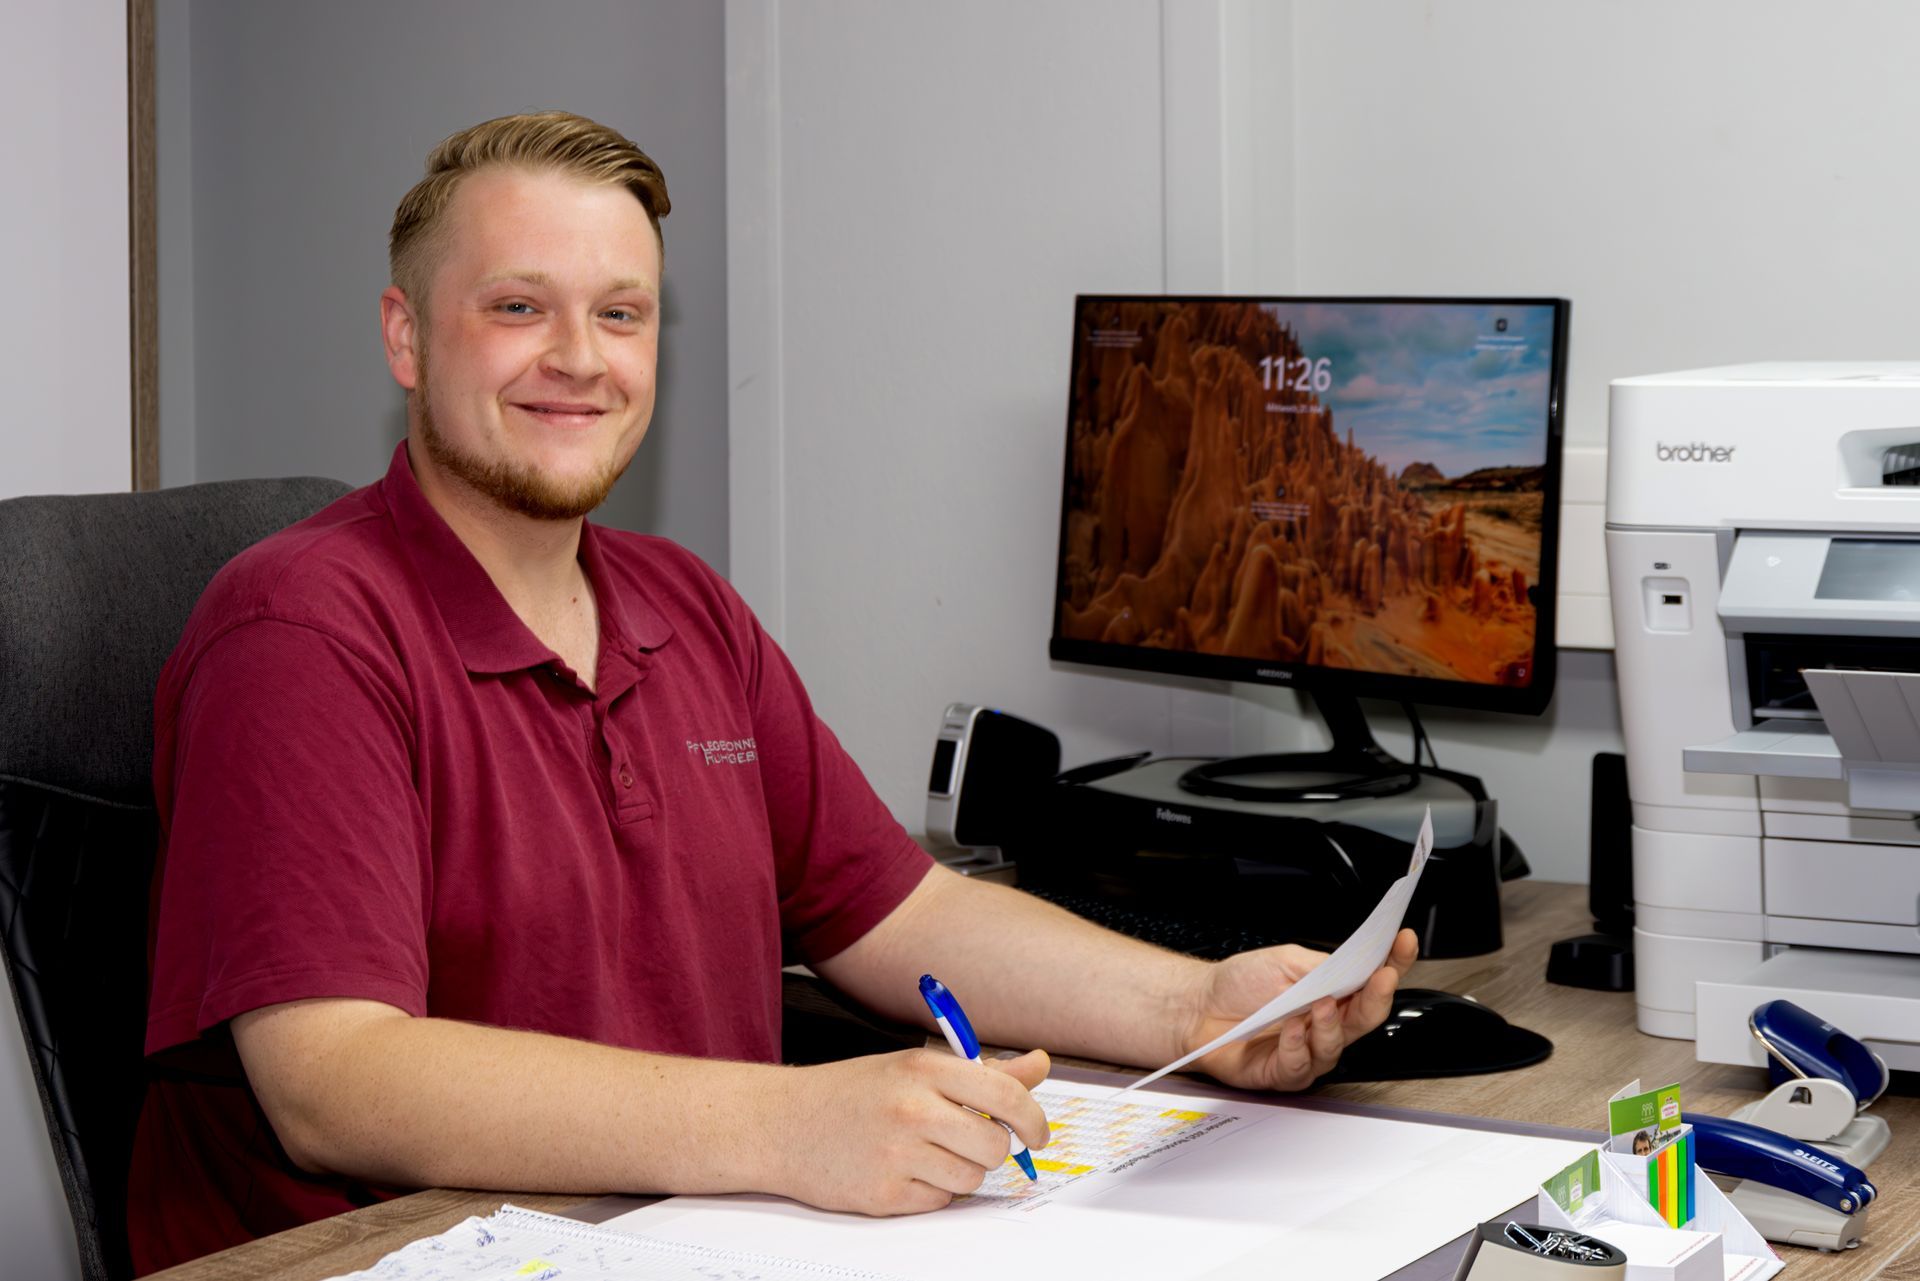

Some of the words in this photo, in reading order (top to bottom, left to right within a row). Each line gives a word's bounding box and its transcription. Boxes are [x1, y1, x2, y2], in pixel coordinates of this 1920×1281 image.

[1260, 356, 1332, 392] 11:26
[1657, 441, 1735, 462] brother
[1801, 1152, 1840, 1173] LEITZ
